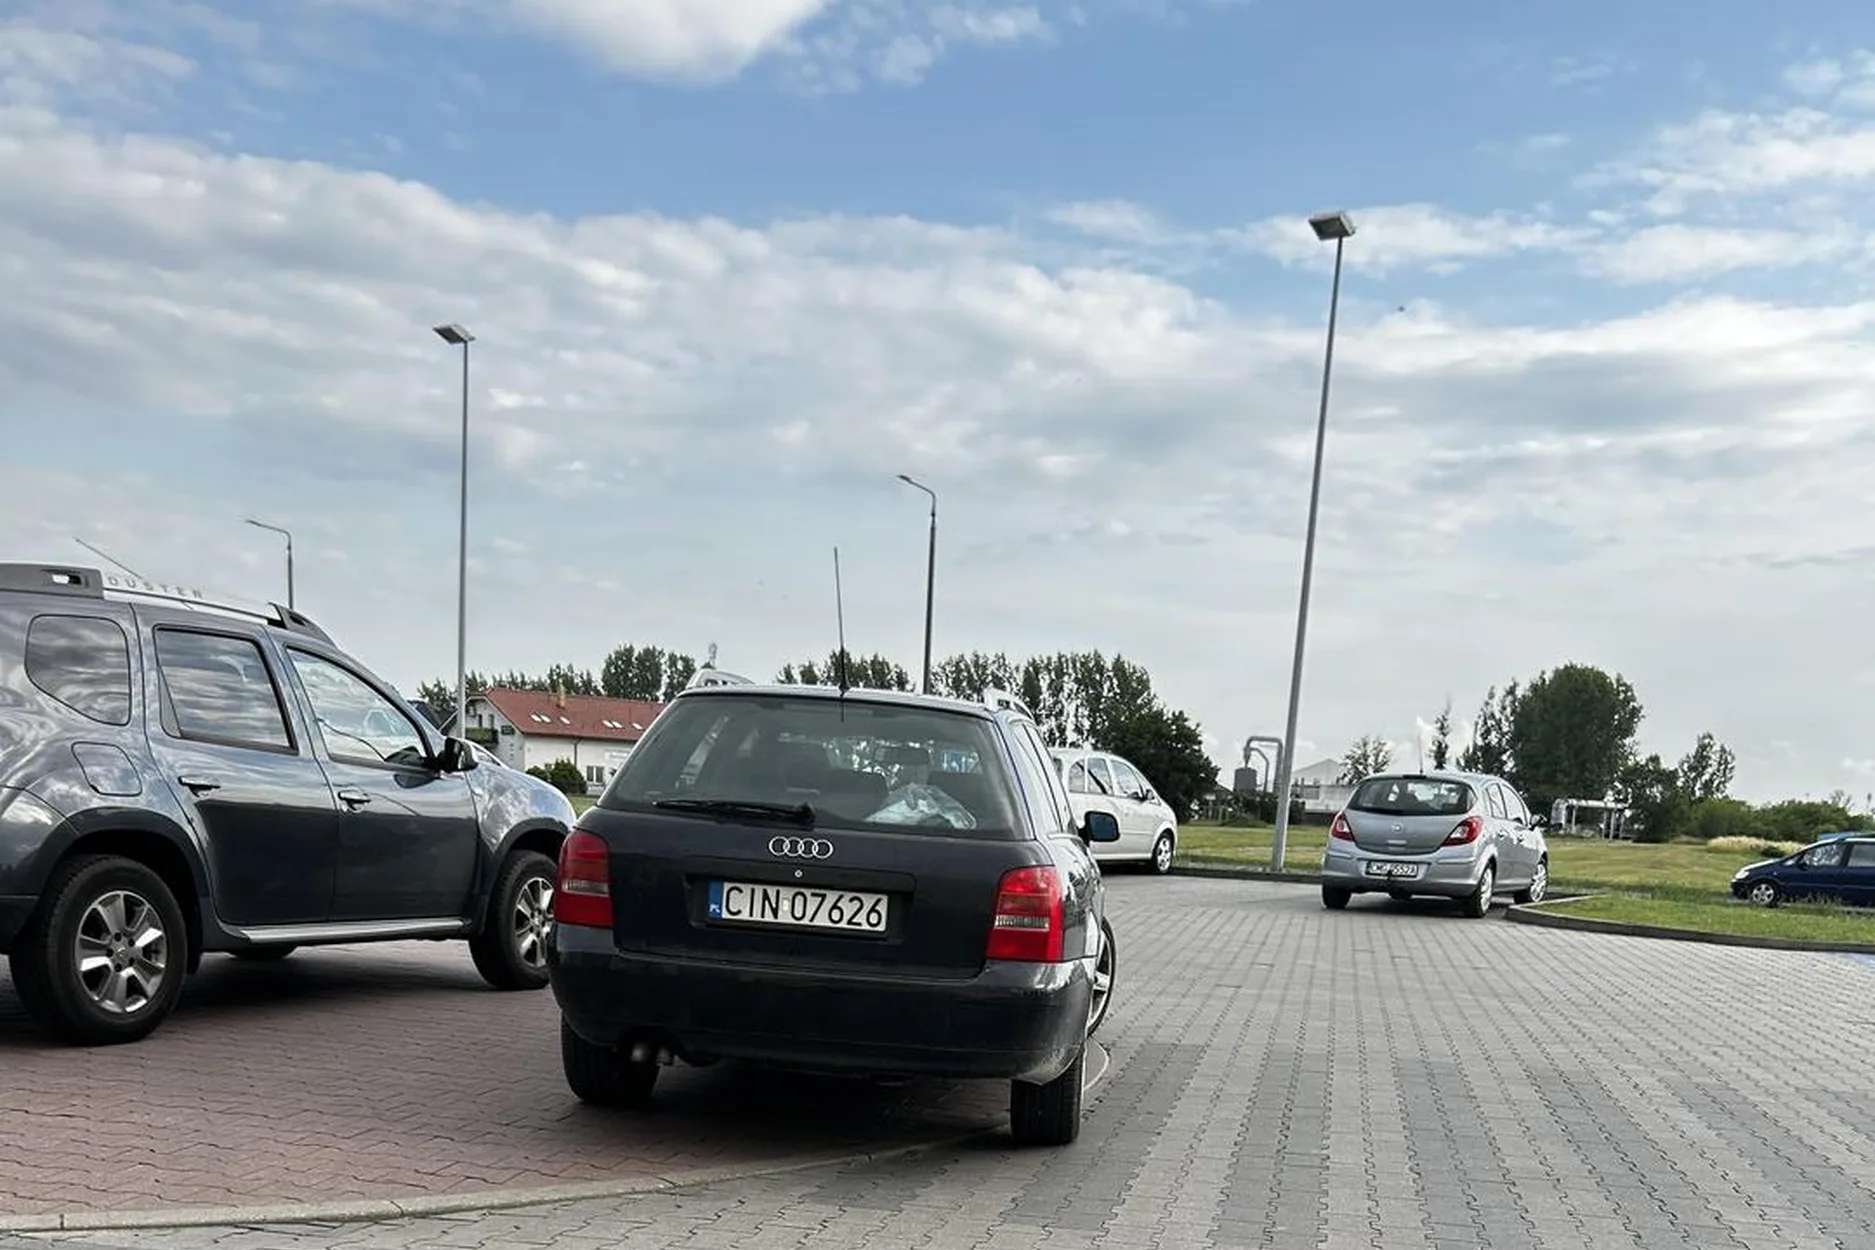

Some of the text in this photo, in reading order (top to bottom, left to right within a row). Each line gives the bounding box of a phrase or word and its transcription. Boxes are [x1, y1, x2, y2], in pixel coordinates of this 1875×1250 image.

[107, 576, 202, 598] DUSTER
[725, 886, 883, 928] CIN 07626
